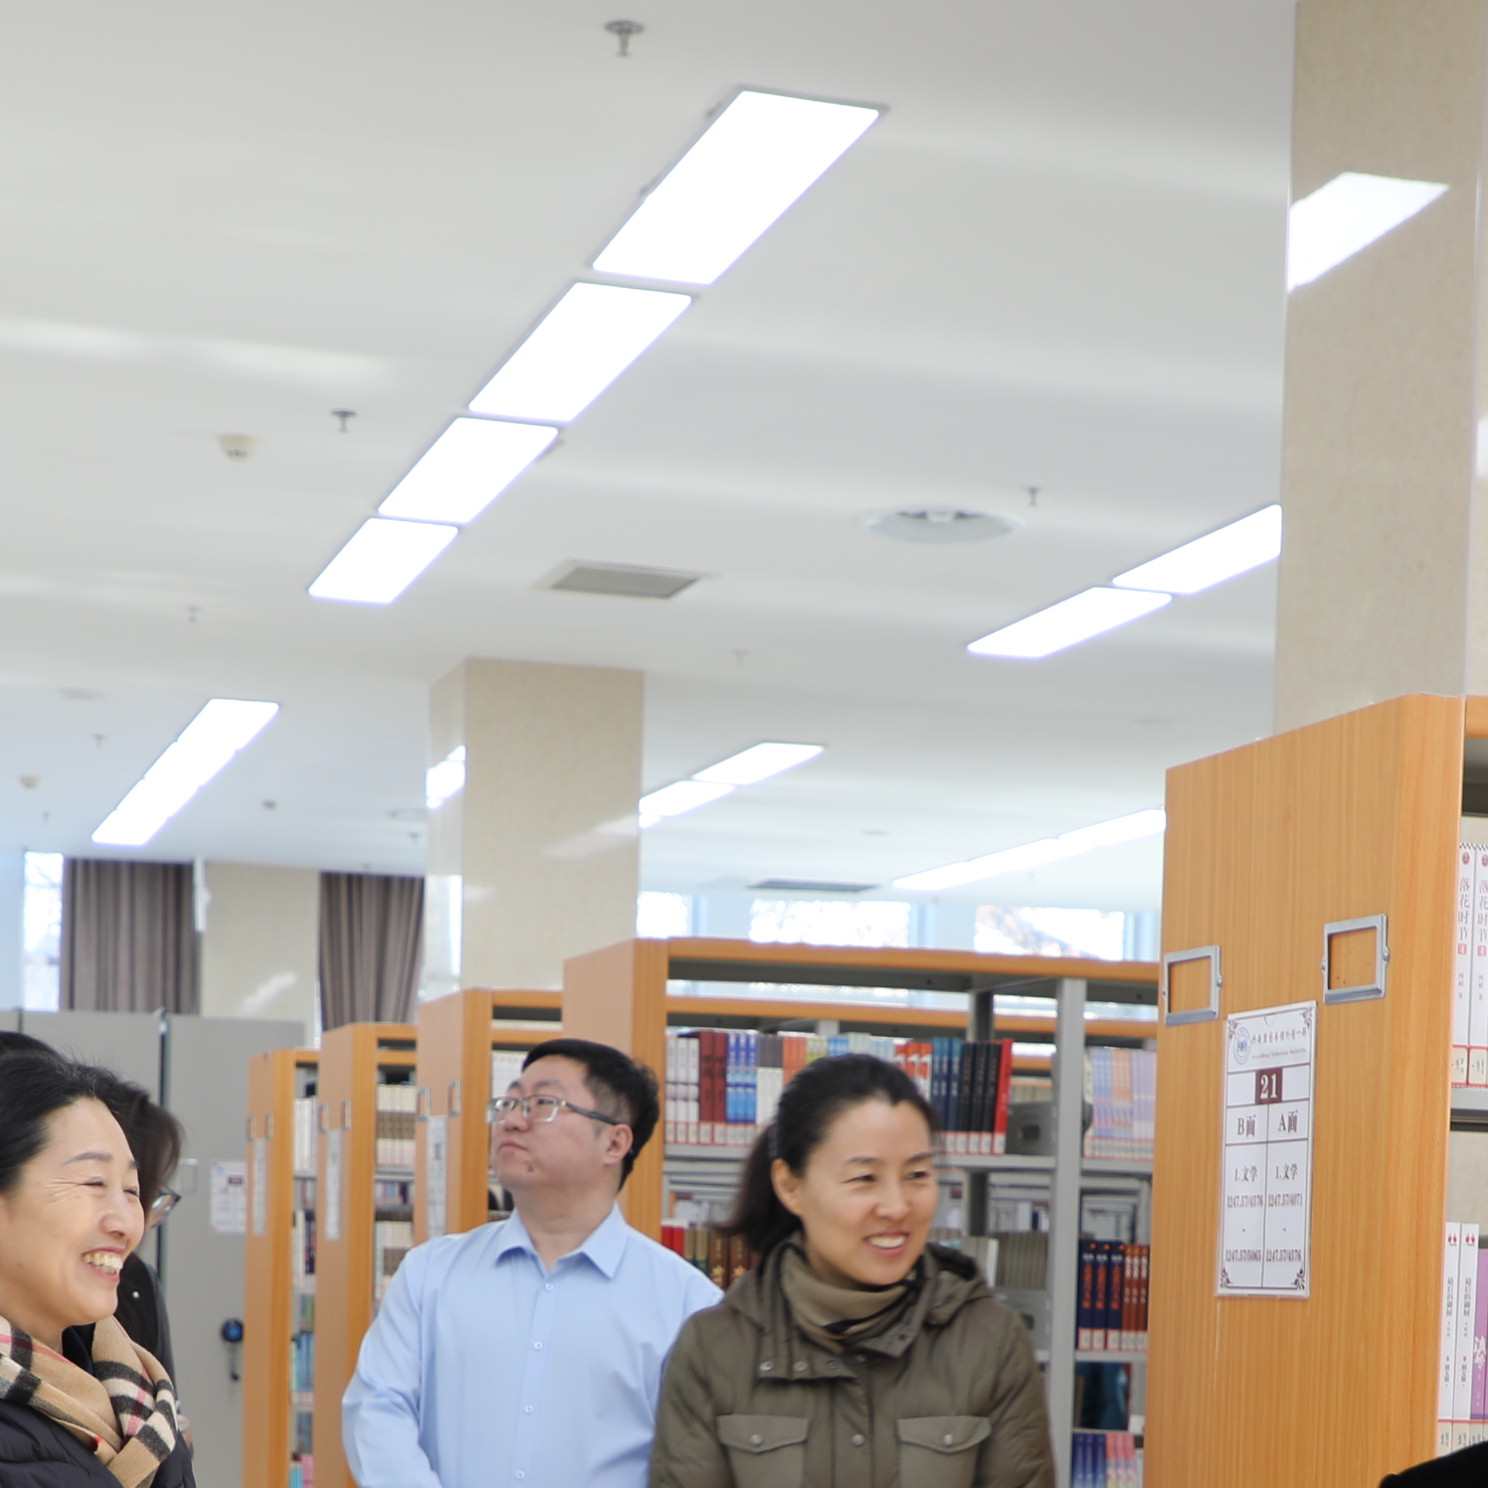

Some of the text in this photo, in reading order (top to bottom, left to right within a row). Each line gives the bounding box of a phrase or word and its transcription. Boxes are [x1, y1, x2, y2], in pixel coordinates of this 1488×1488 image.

[1260, 1074, 1278, 1099] 21
[1237, 1114, 1256, 1137] B面
[1277, 1110, 1298, 1134] A面
